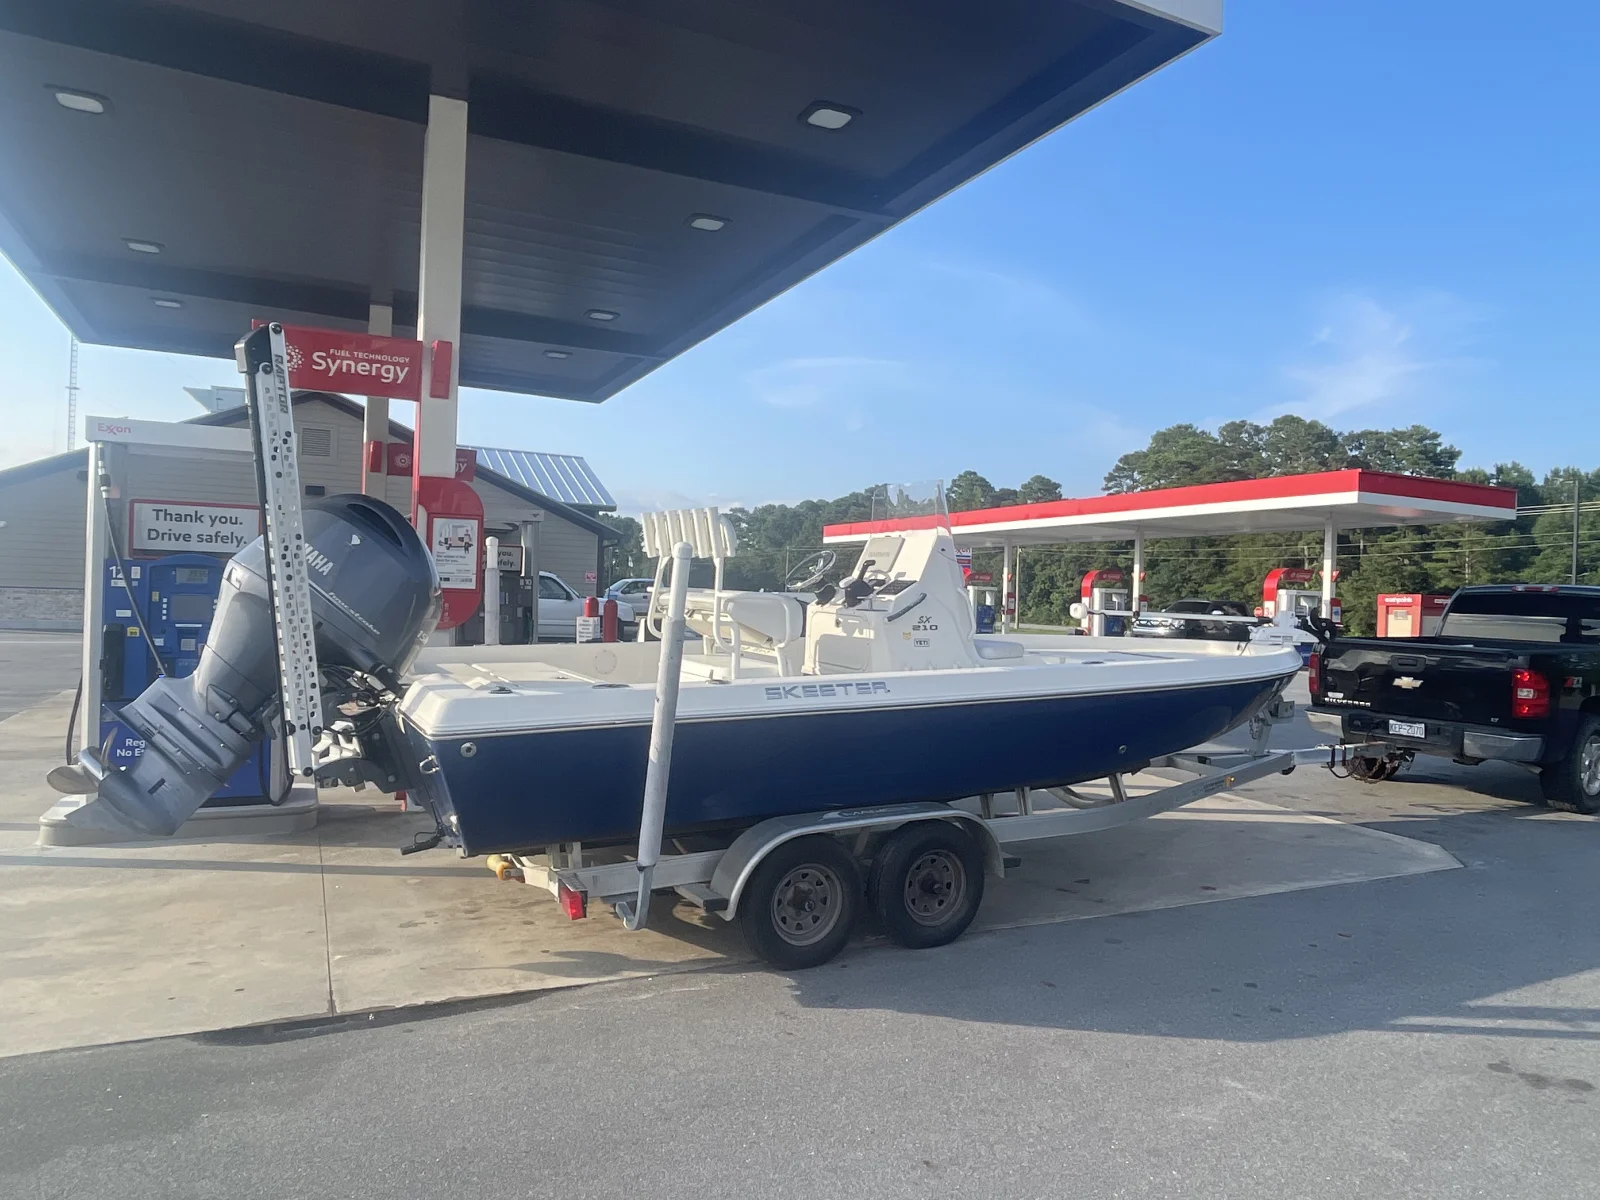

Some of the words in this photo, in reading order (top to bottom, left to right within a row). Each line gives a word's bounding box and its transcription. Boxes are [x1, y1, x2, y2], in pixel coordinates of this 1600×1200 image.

[330, 349, 351, 358] FUEL
[353, 351, 410, 363] TECHNOLOGY
[312, 351, 409, 383] Synergy
[274, 354, 289, 414] RAPTOR
[97, 423, 132, 435] Exxon
[152, 509, 204, 524] Thank
[208, 514, 243, 527] you.
[147, 528, 192, 543] Drive
[196, 531, 248, 548] safely.
[764, 682, 887, 700] SKEETER
[116, 748, 132, 757] No
